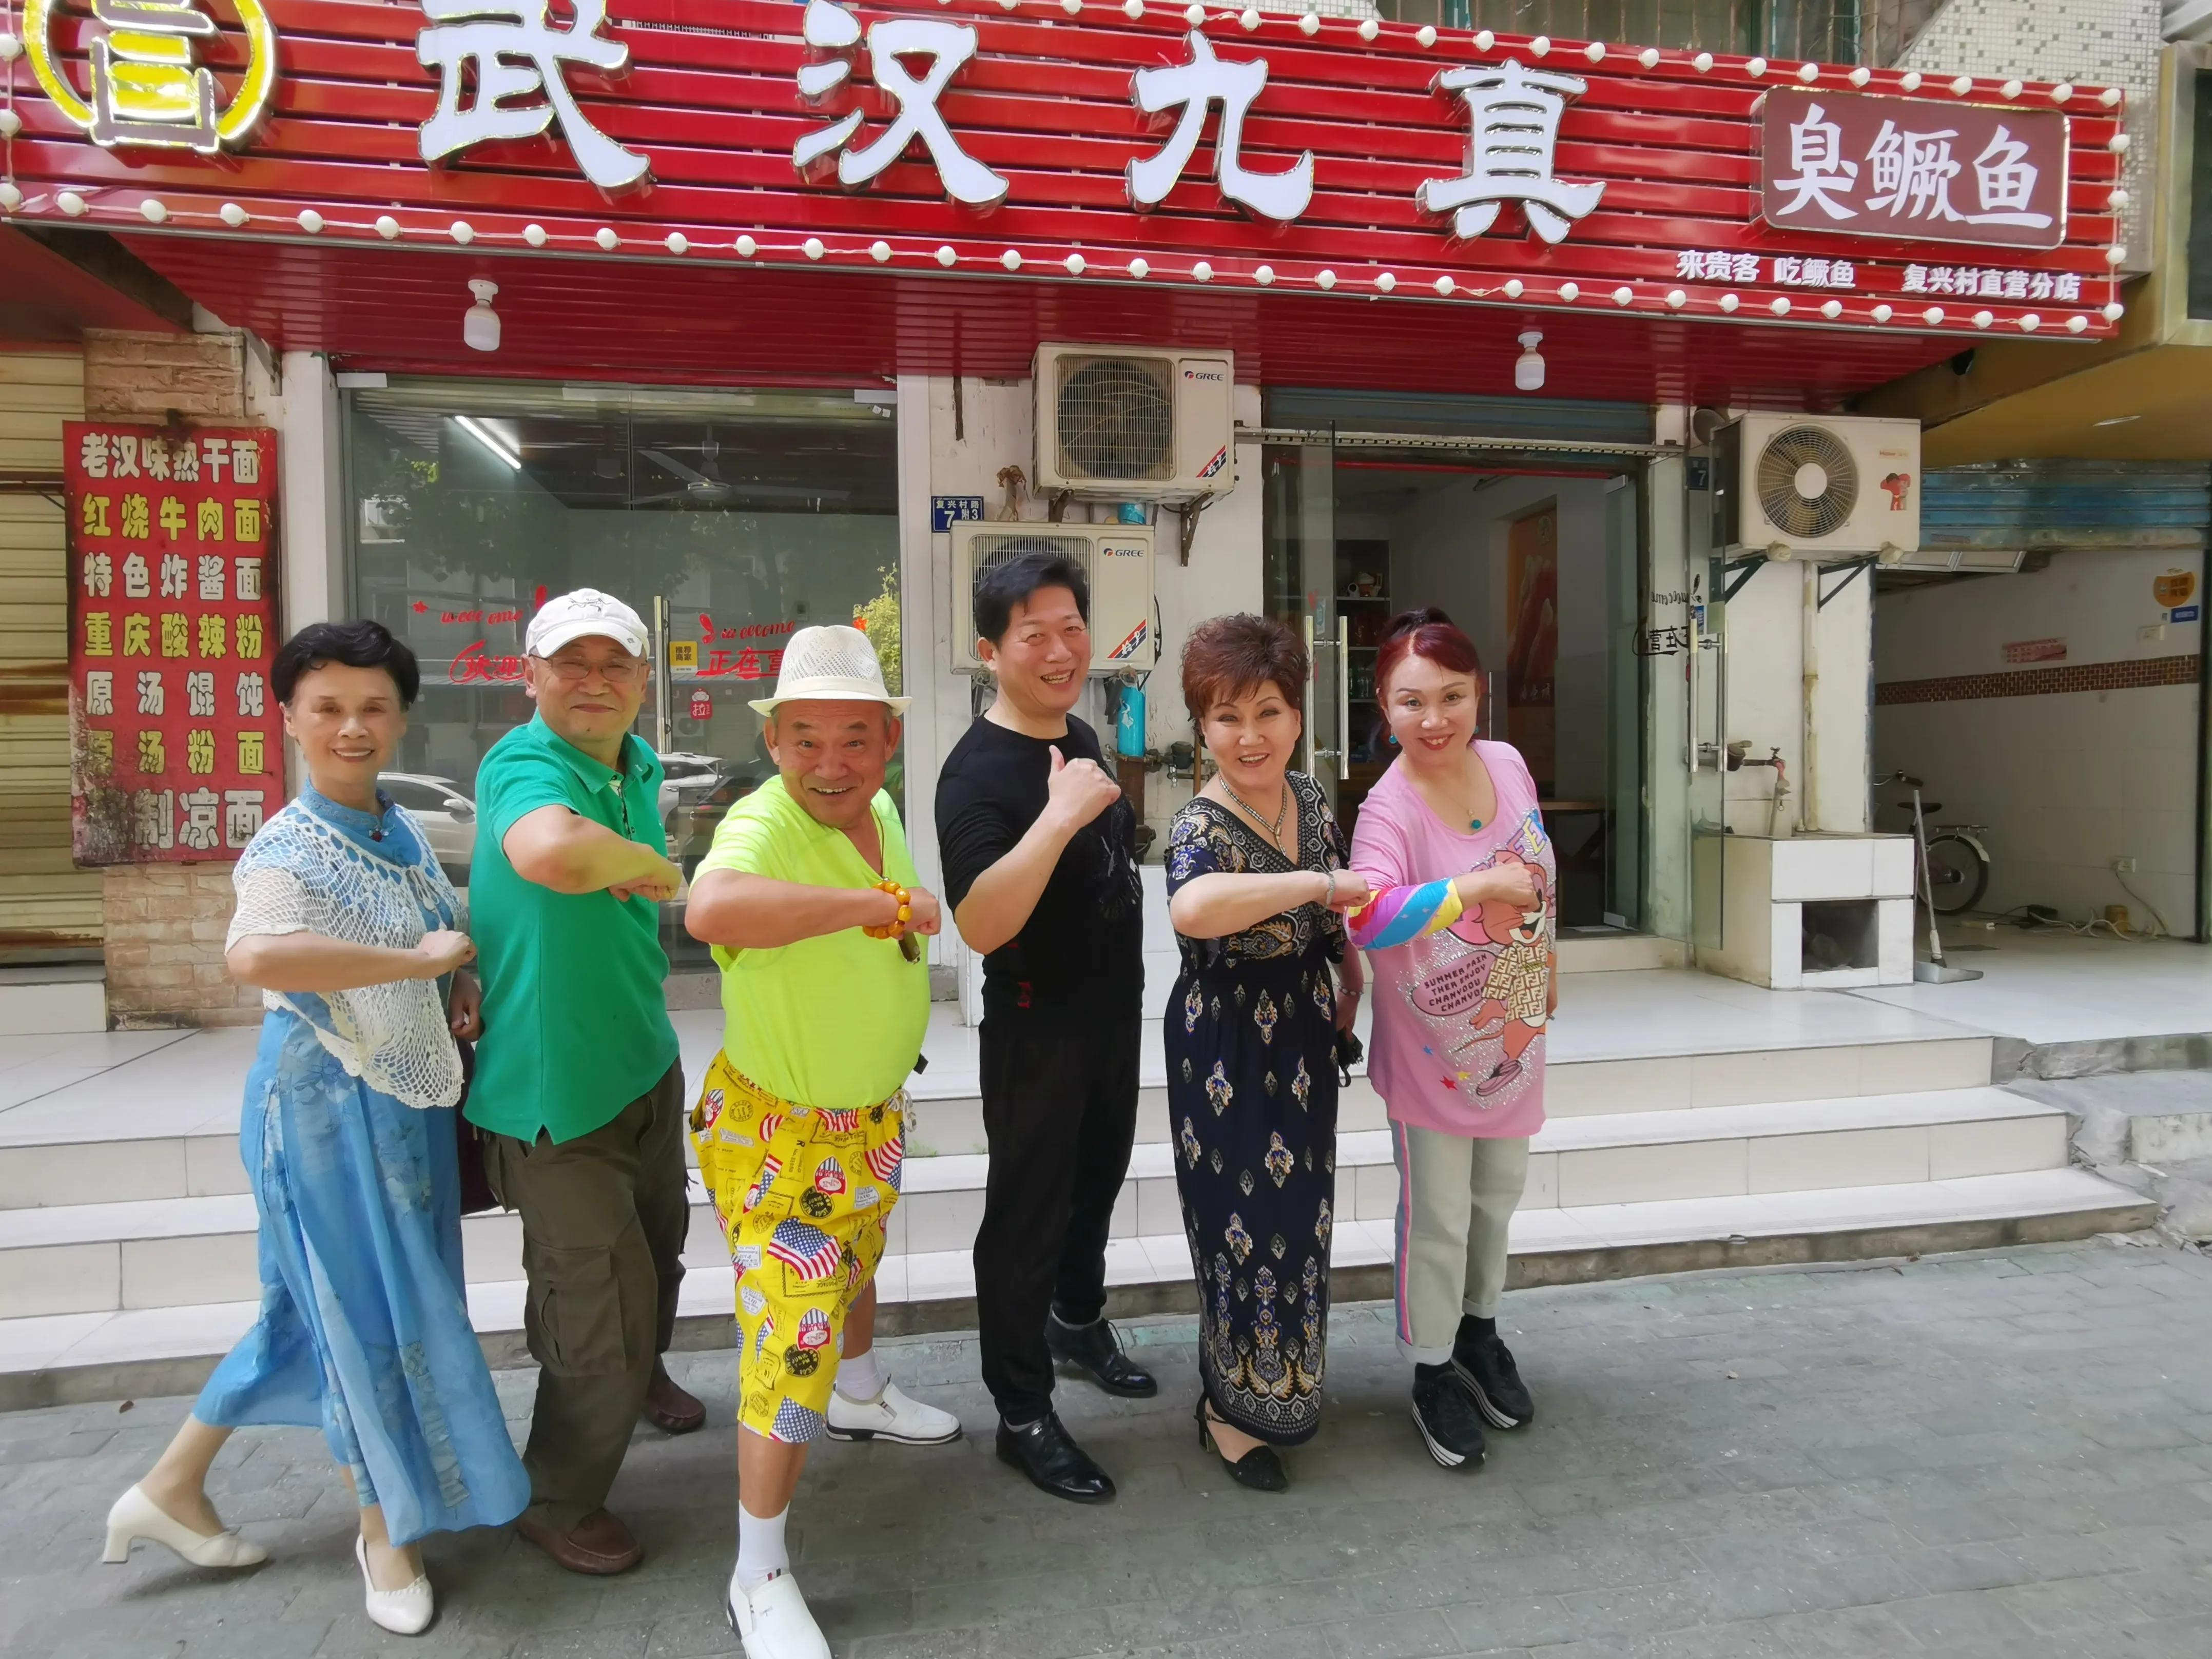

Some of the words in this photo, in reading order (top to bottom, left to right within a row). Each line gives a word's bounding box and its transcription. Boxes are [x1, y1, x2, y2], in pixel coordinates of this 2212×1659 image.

[415, 0, 1606, 244] 武汉九真
[1773, 102, 2052, 229] 臭鳜鱼
[1676, 250, 1760, 282] 来贵客
[1774, 257, 1856, 288] 吃鳜鱼
[1901, 264, 2081, 301] 复兴村直营分店
[1195, 373, 1224, 381] GREE
[81, 432, 259, 483] 老汉味热干面
[1698, 470, 1706, 486] 7
[83, 492, 261, 542] 红烧牛肉面
[936, 500, 979, 509] 复兴村路
[944, 511, 955, 528] 7
[84, 552, 262, 600] 特色炸酱面
[84, 612, 263, 659] 重庆酸辣粉
[86, 671, 264, 716] 原汤馄饨
[692, 704, 706, 716] 拉
